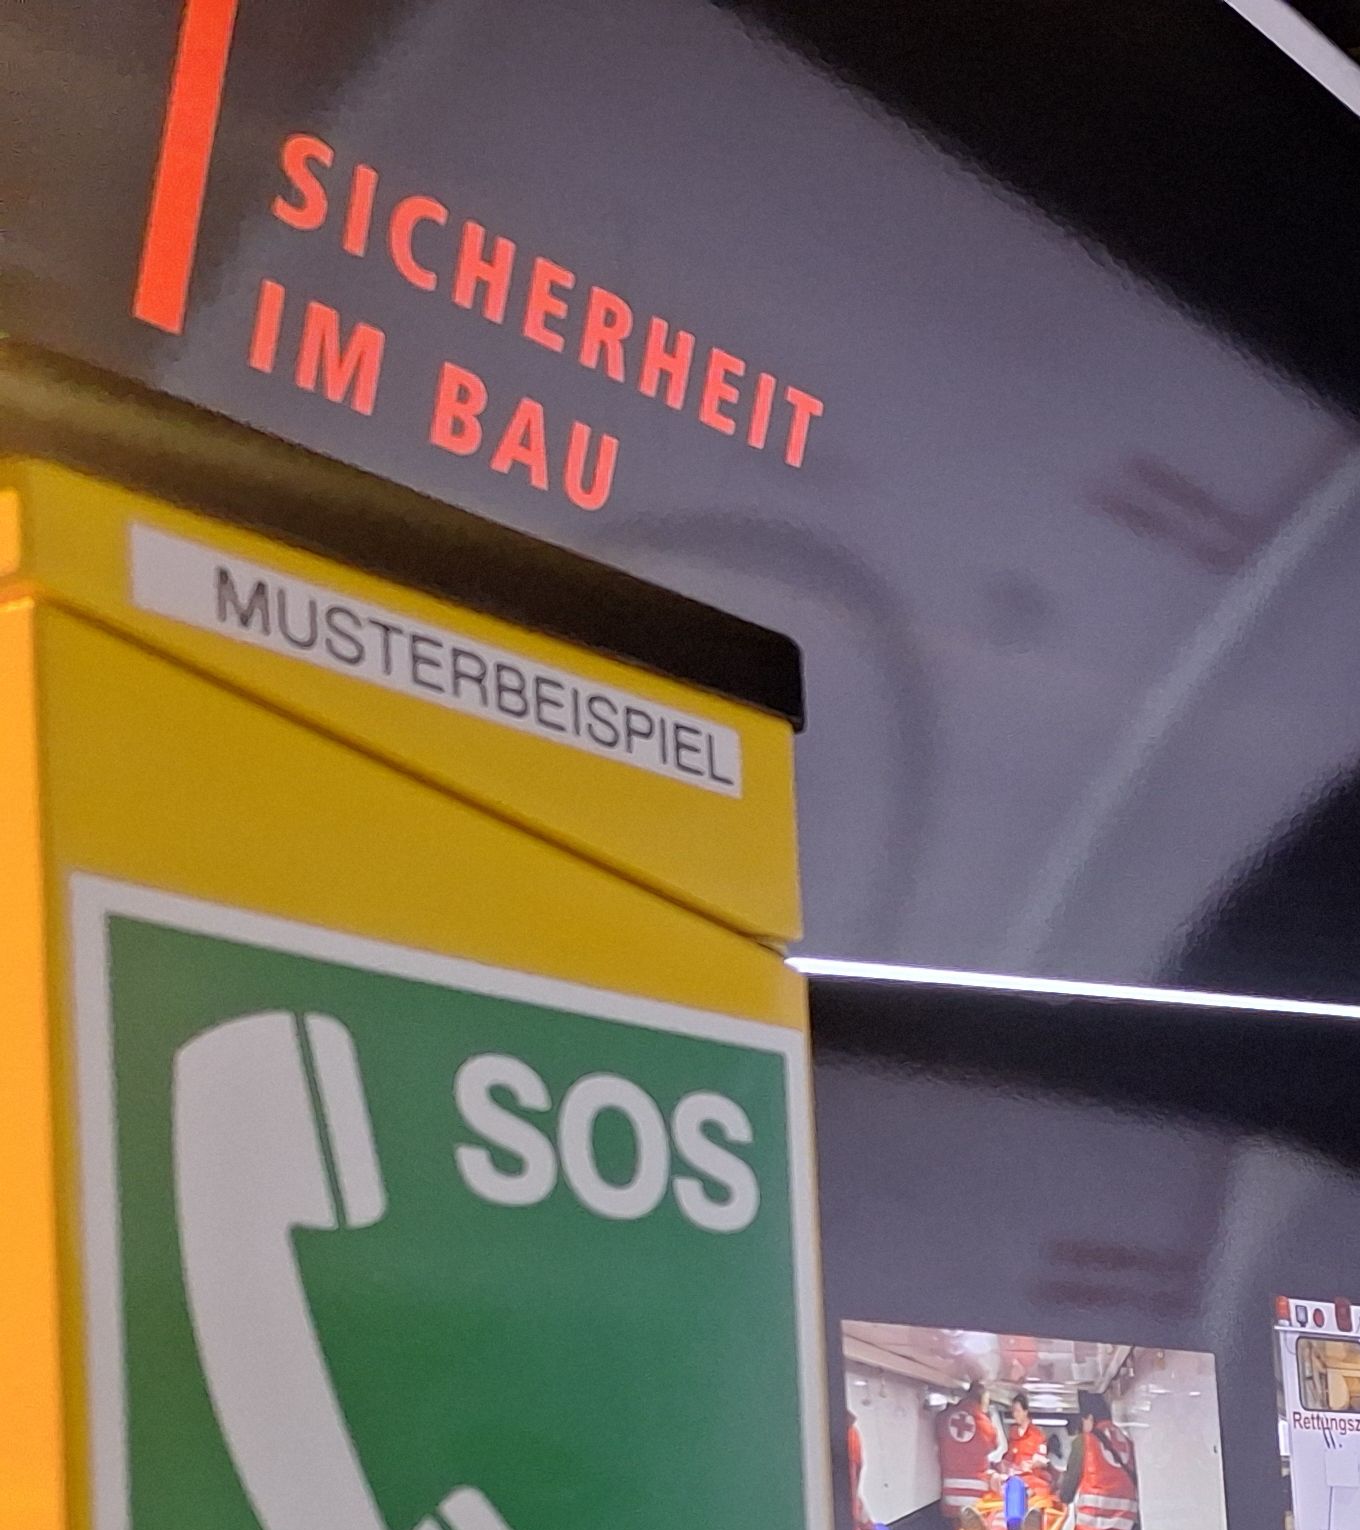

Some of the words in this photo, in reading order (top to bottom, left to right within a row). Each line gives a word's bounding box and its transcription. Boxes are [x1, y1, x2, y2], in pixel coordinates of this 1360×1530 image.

[248, 278, 386, 416] IM
[430, 362, 620, 511] BAU
[271, 131, 824, 468] SICHERHEIT
[215, 566, 735, 786] MUSTERBEISPIEL
[453, 1052, 761, 1234] SOS
